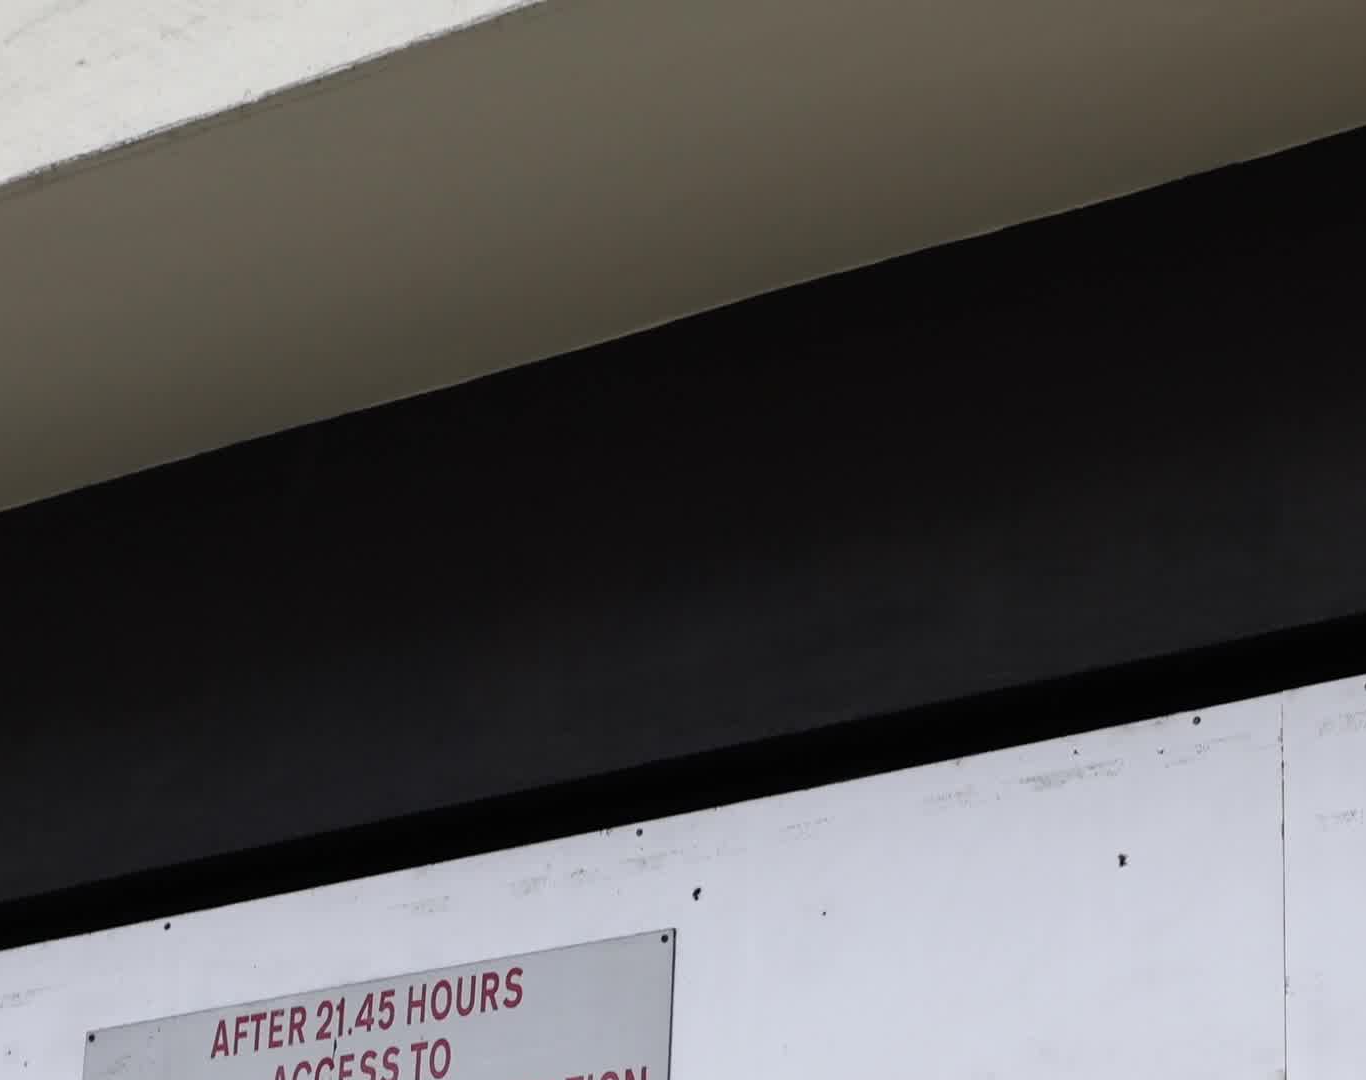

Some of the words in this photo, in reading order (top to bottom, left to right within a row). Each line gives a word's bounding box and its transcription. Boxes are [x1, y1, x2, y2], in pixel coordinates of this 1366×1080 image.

[211, 1007, 307, 1059] AFTER
[316, 988, 396, 1040] 21.45
[407, 966, 524, 1025] HOURS
